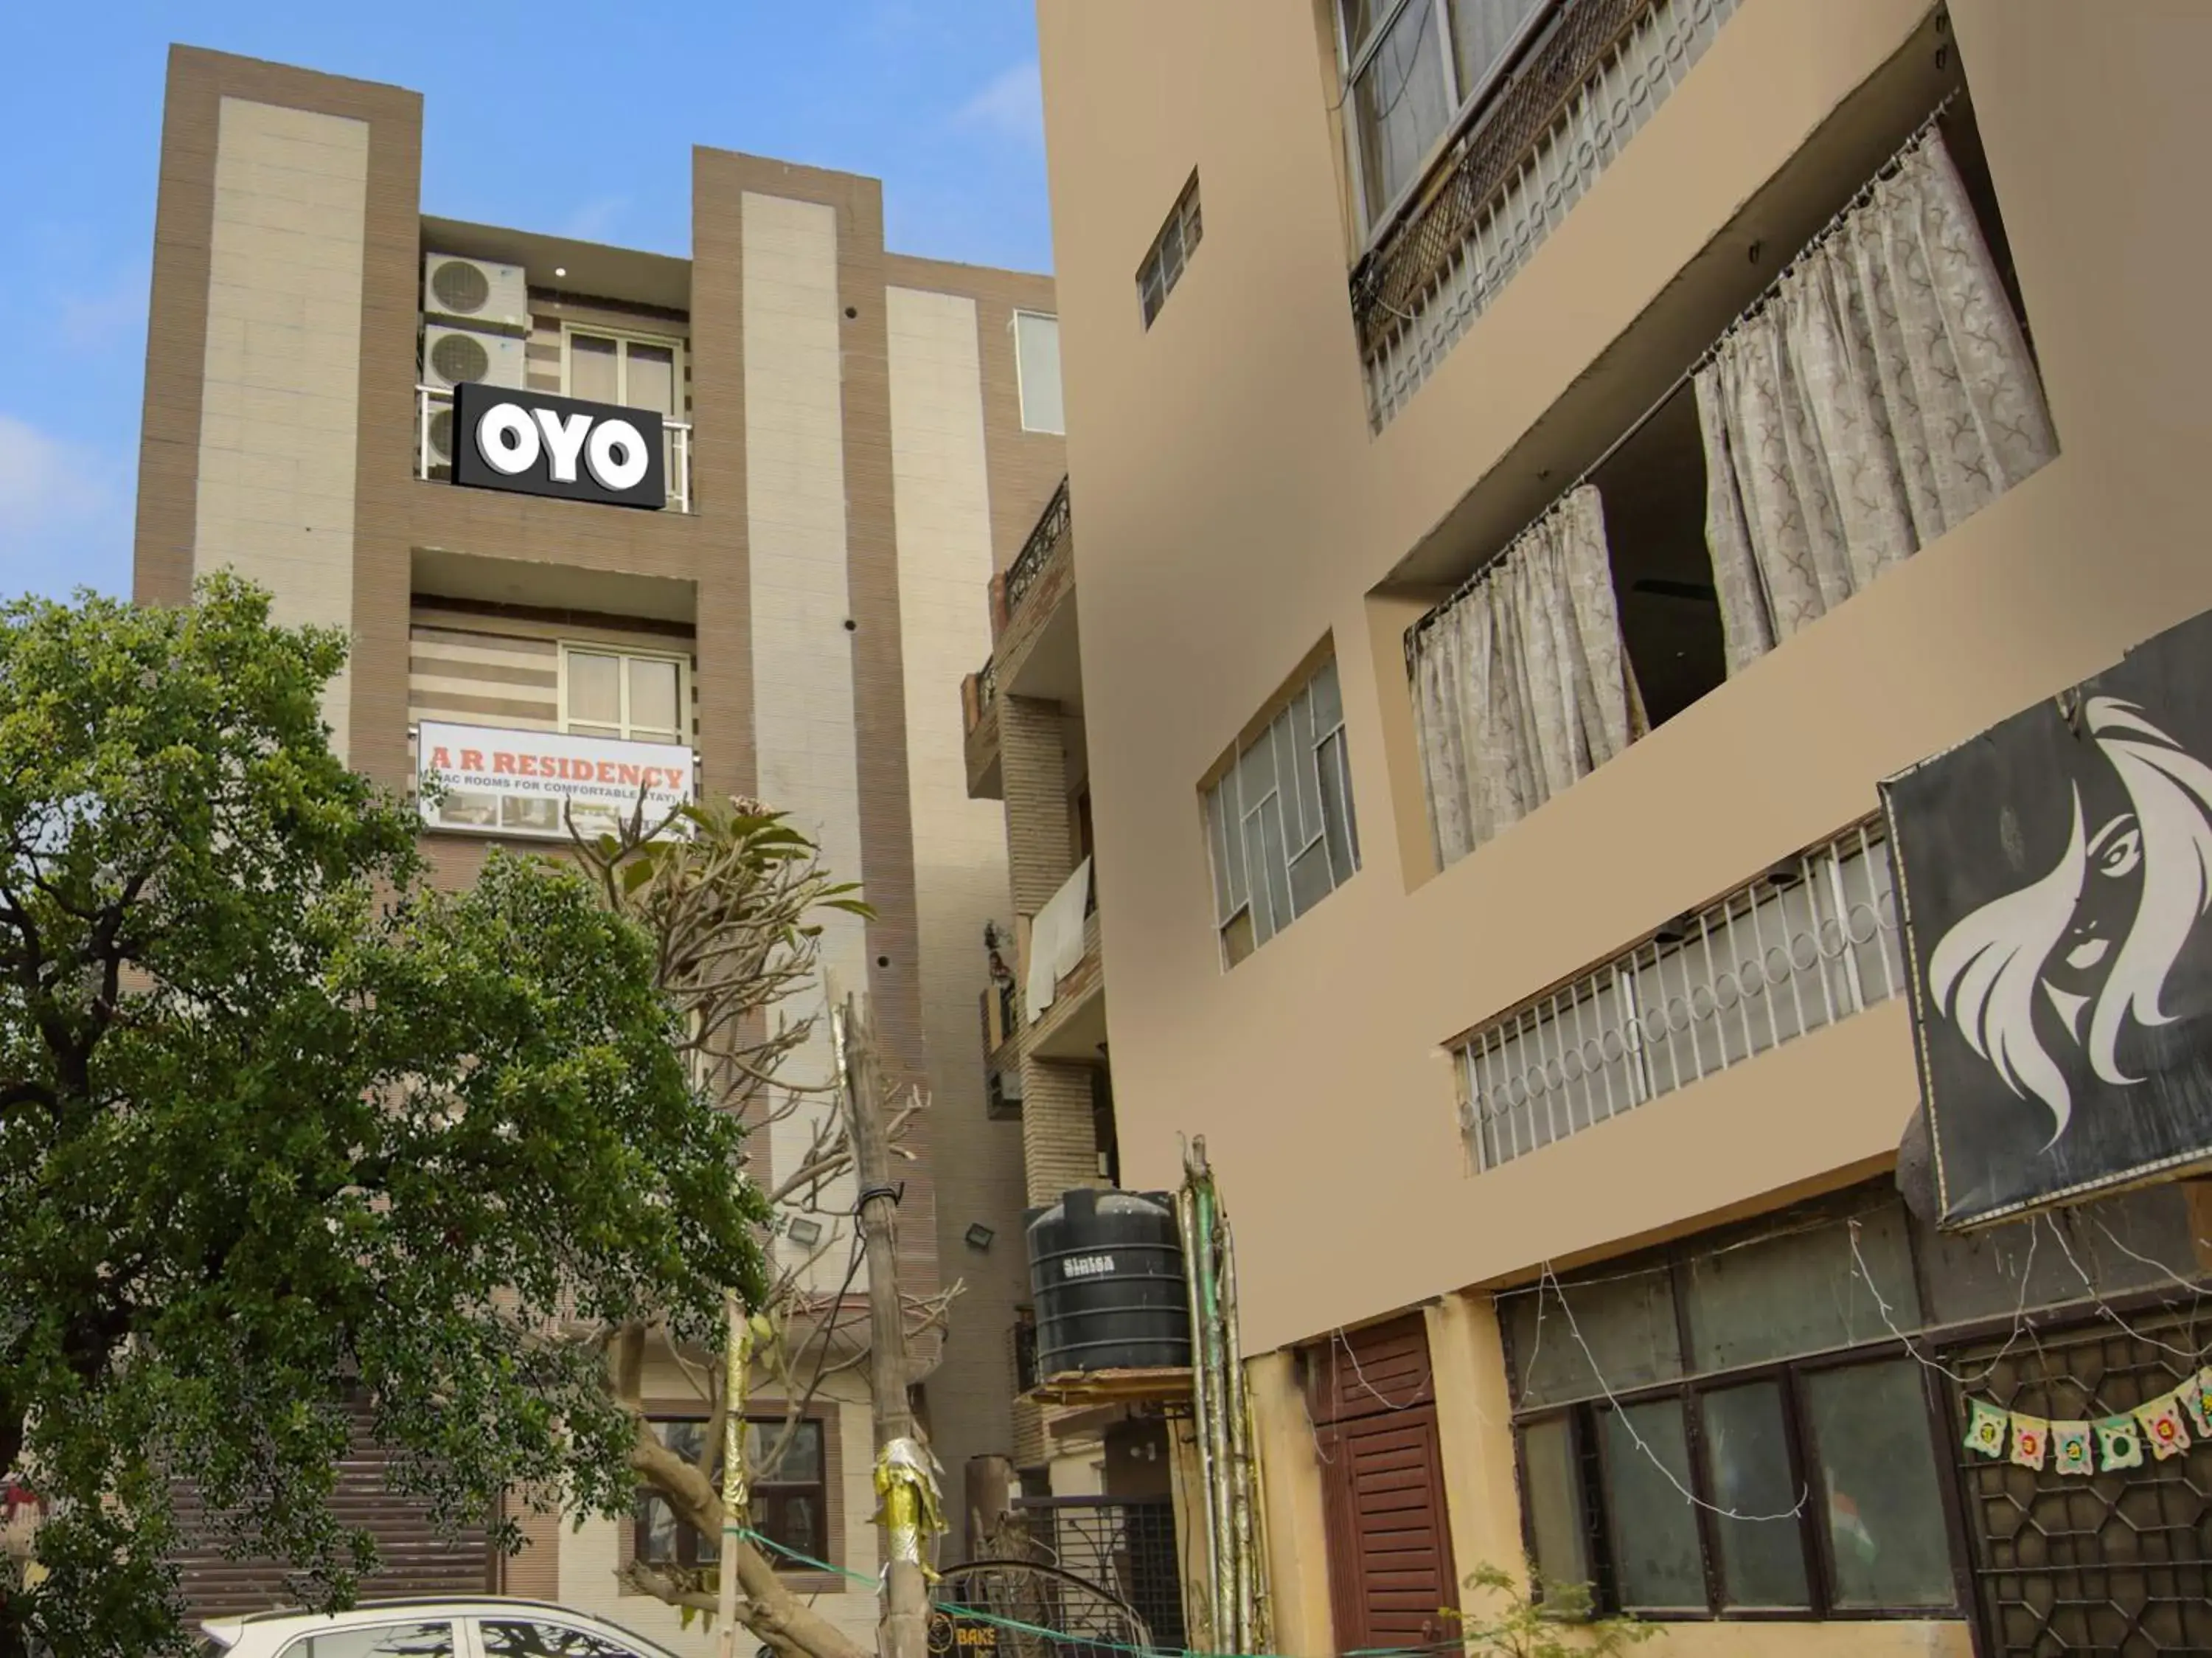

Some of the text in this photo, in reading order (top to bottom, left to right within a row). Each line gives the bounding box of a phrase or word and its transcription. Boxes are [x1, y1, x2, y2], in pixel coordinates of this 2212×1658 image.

[476, 403, 649, 491] OYO
[432, 746, 684, 789] A R RESIDENCY
[465, 776, 510, 788] ROOMS
[515, 780, 540, 791] FOR
[544, 783, 637, 799] COMFORTABLE
[640, 789, 676, 803] TAY)
